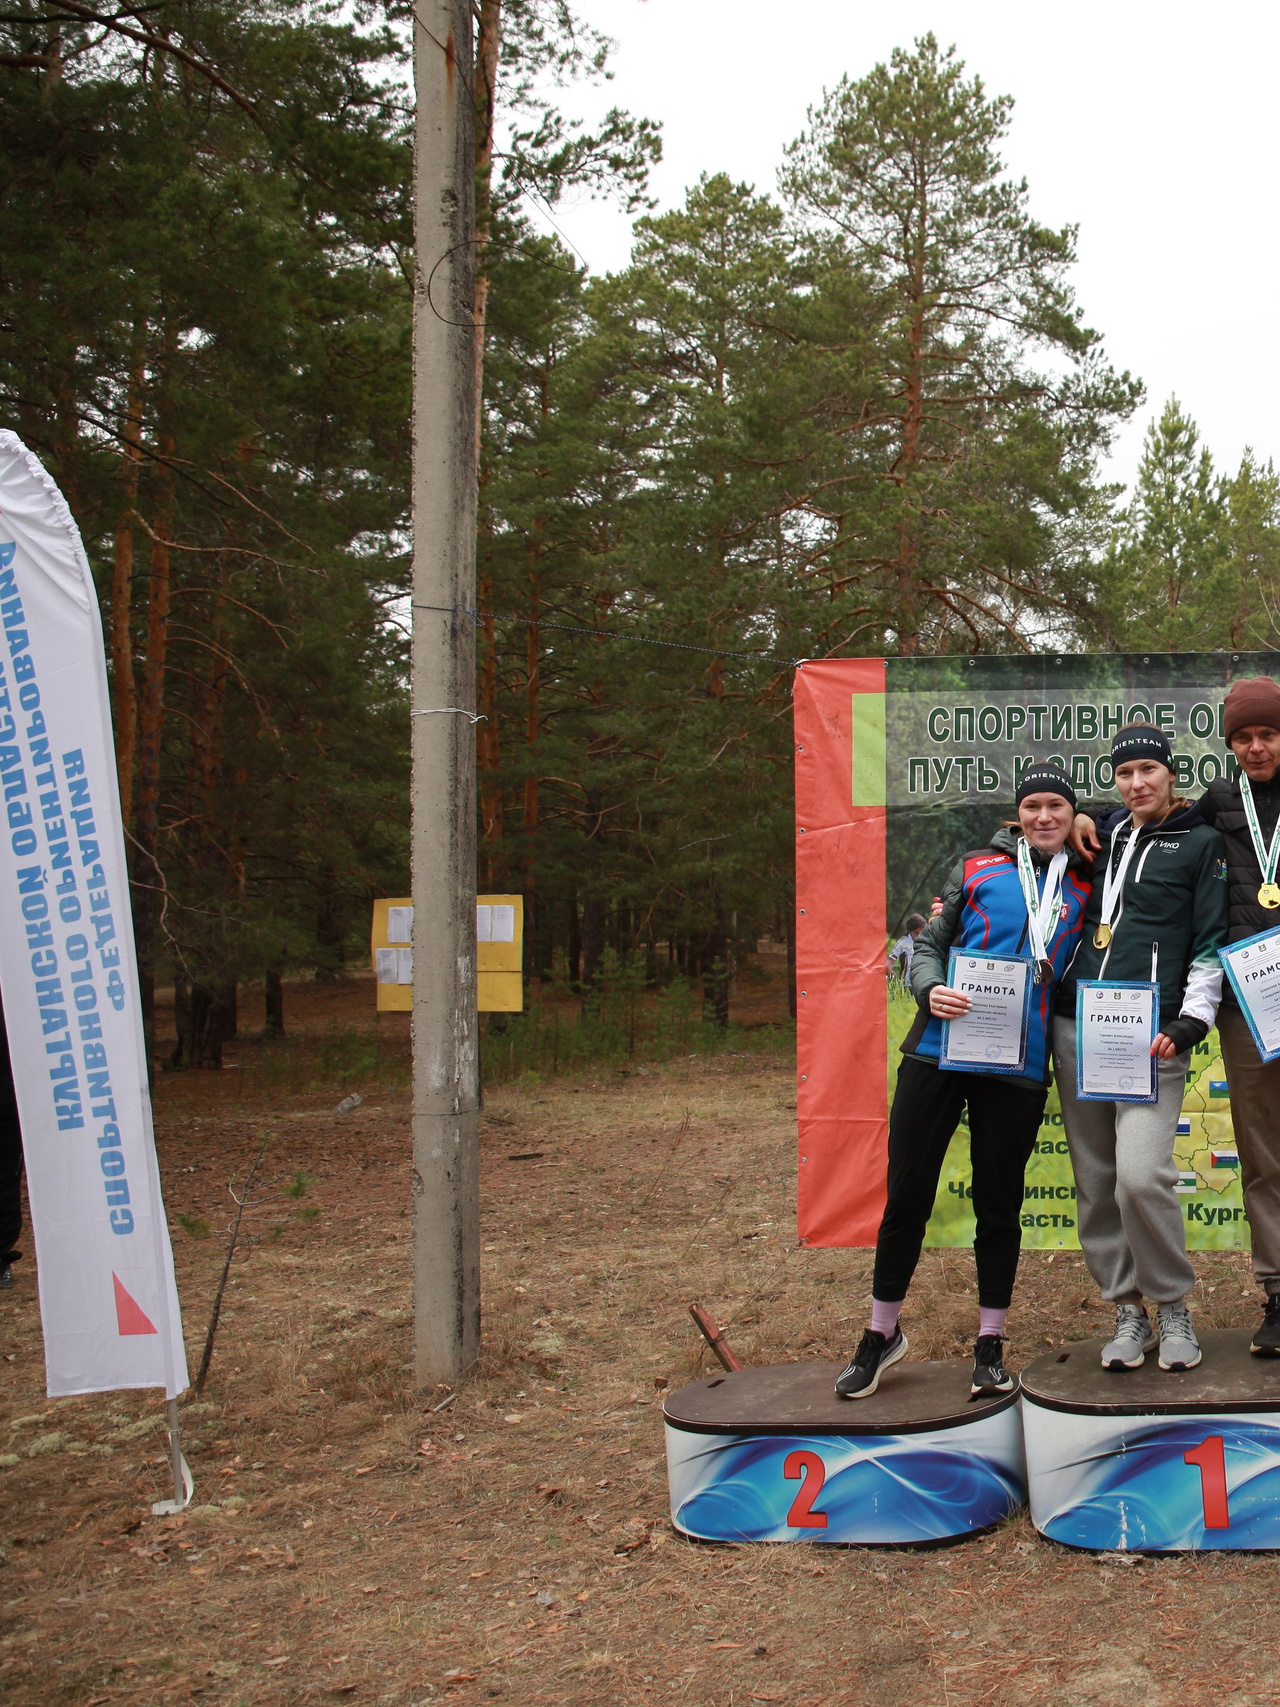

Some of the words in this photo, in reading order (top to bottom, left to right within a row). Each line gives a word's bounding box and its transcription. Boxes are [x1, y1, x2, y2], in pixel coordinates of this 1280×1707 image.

[927, 702, 1176, 743] СПОРТИВНОЕ
[908, 755, 1000, 793] ПУТЬ
[961, 983, 1016, 996] ГРАМОТА
[1090, 1014, 1144, 1024] ГРАМОТА
[783, 1449, 828, 1529] 2
[1183, 1435, 1230, 1529] 1
